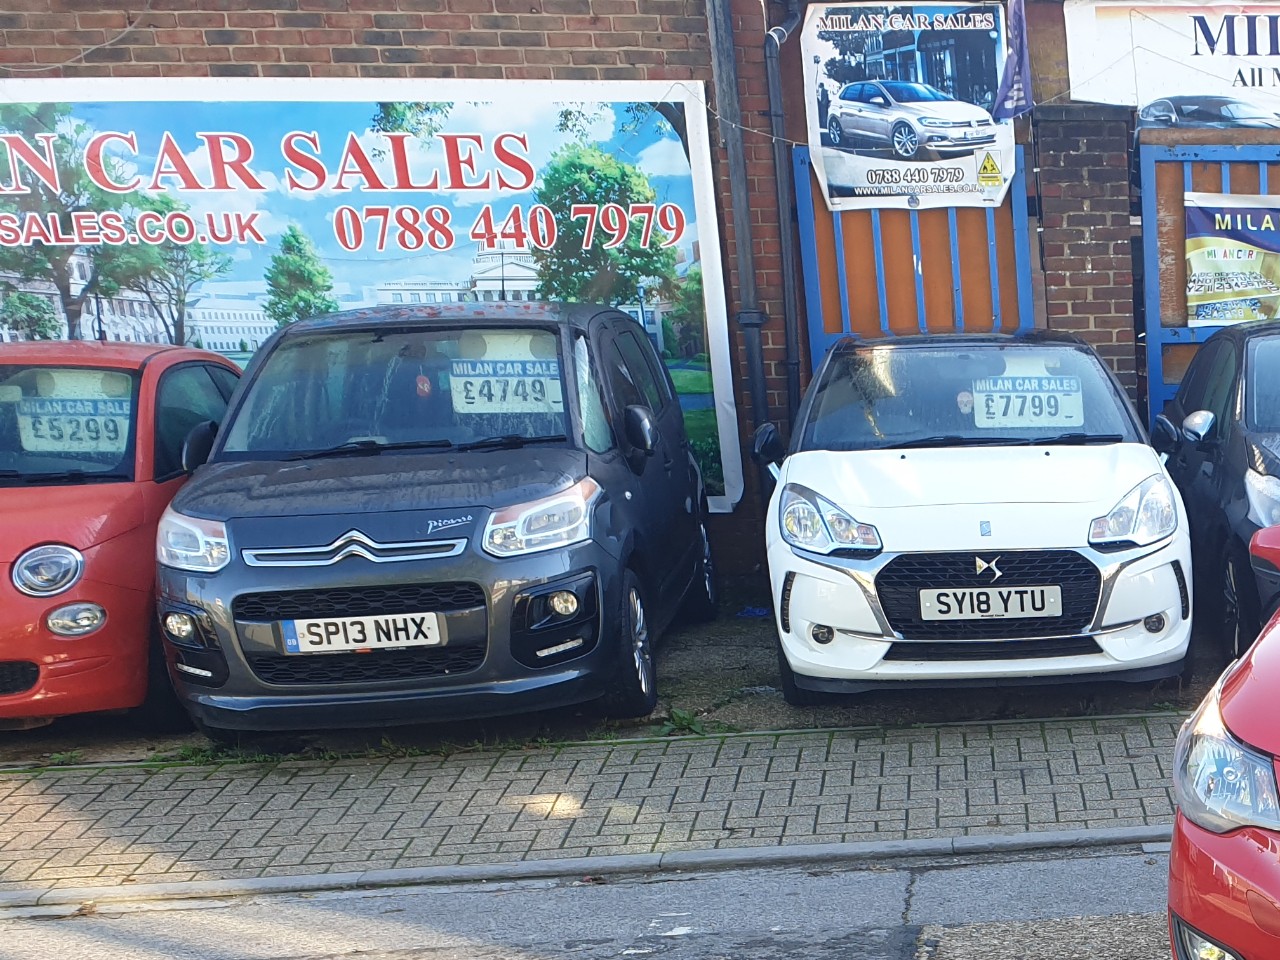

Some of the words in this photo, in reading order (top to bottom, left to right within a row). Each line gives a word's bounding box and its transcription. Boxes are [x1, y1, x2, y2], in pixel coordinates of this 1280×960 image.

[818, 15, 885, 30] MILAN
[888, 14, 931, 30] CAR
[934, 14, 995, 30] SALES
[1232, 67, 1263, 87] All
[85, 132, 267, 192] CAR
[283, 132, 536, 192] SALES
[867, 169, 900, 184] 0788
[903, 168, 928, 183] 440
[931, 168, 964, 182] 7979
[334, 205, 455, 250] 0788
[471, 205, 556, 249] 440
[570, 204, 686, 248] 7979
[452, 362, 493, 375] MILAN
[496, 362, 523, 375] CAR
[463, 379, 546, 403] £4749
[976, 379, 1012, 391] MILAN
[1015, 379, 1039, 391] CAR
[1042, 379, 1078, 391] SALES
[21, 400, 62, 414] MILAN
[66, 400, 94, 414] CAR
[984, 394, 1059, 417] £7799
[31, 418, 119, 441] £5299
[936, 591, 991, 615] SY18
[998, 589, 1046, 614] YTU
[306, 620, 367, 646] SP13
[374, 616, 429, 643] NHX
